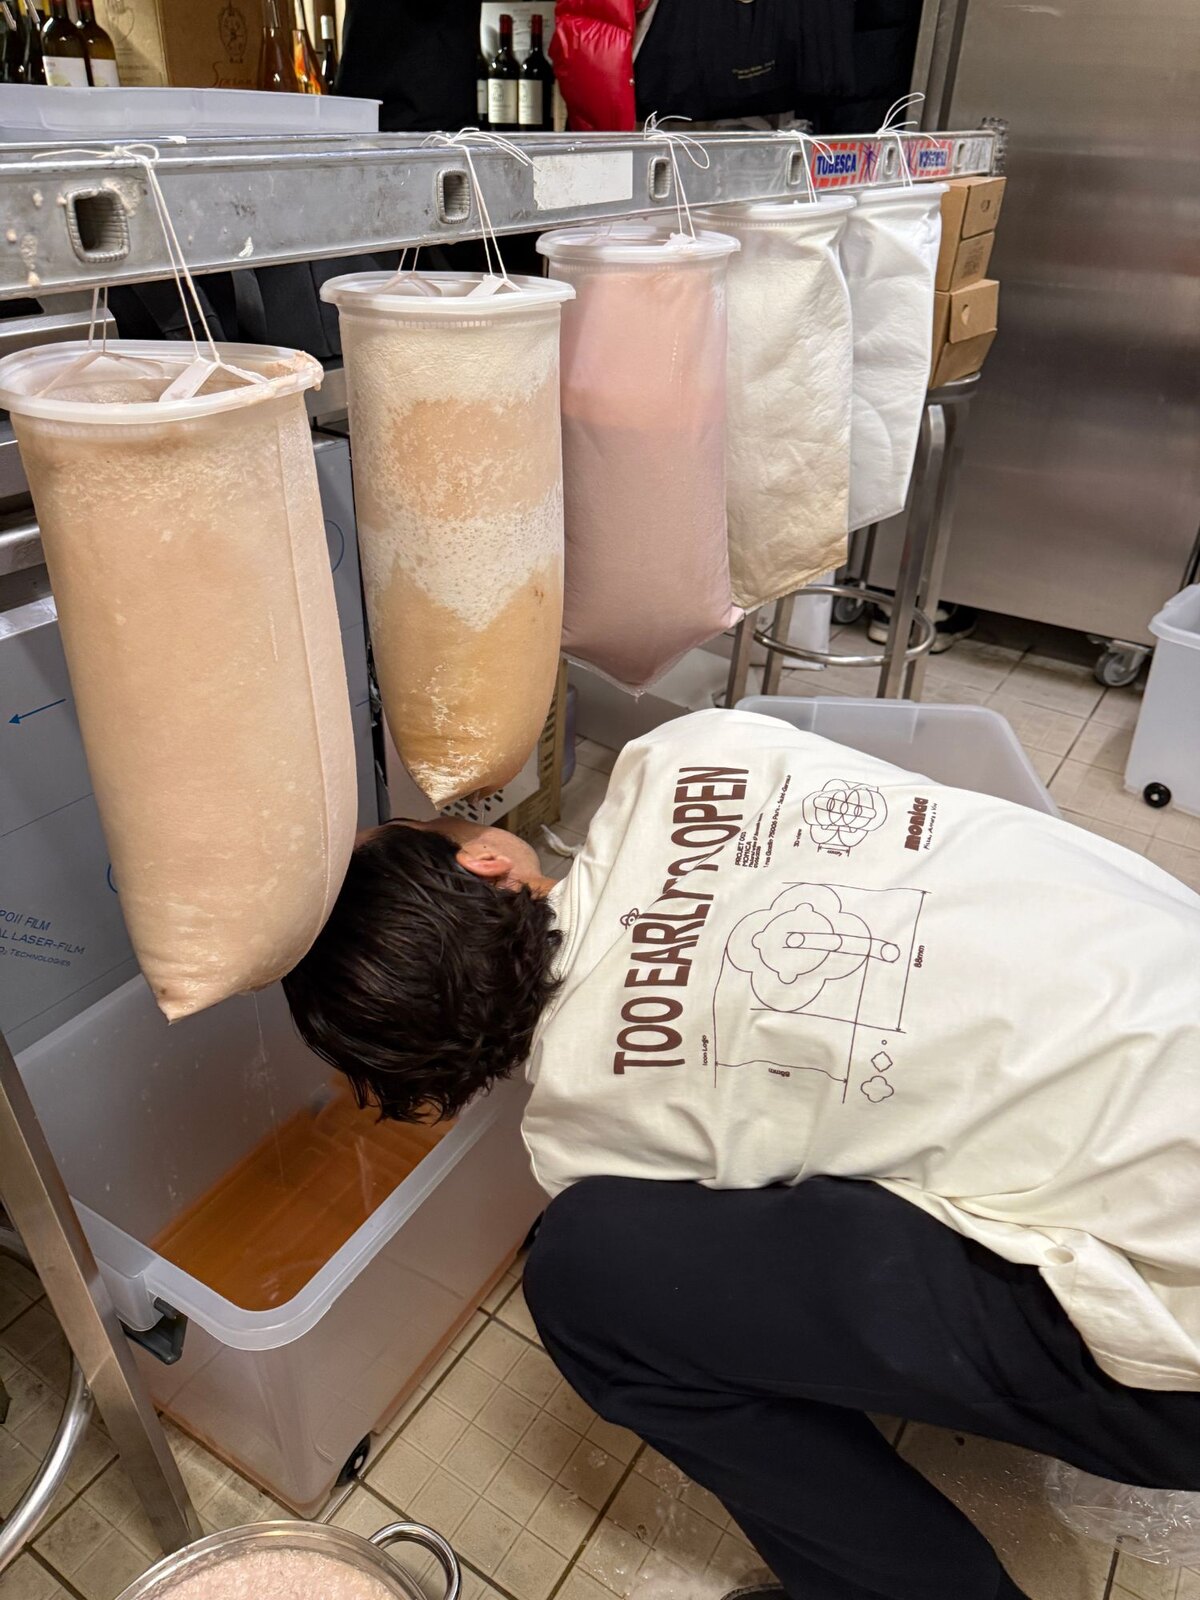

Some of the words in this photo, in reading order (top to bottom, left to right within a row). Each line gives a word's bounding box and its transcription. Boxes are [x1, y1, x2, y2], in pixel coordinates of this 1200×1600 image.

[671, 766, 749, 848] OPEN
[734, 842, 744, 866] PROJET
[742, 842, 751, 867] MONICA
[25, 916, 51, 931] FILM
[12, 932, 86, 955] LASER-FILM
[624, 888, 715, 988] EARLY
[10, 948, 71, 967] TECHNOLOGIES
[613, 996, 685, 1075] TOO
